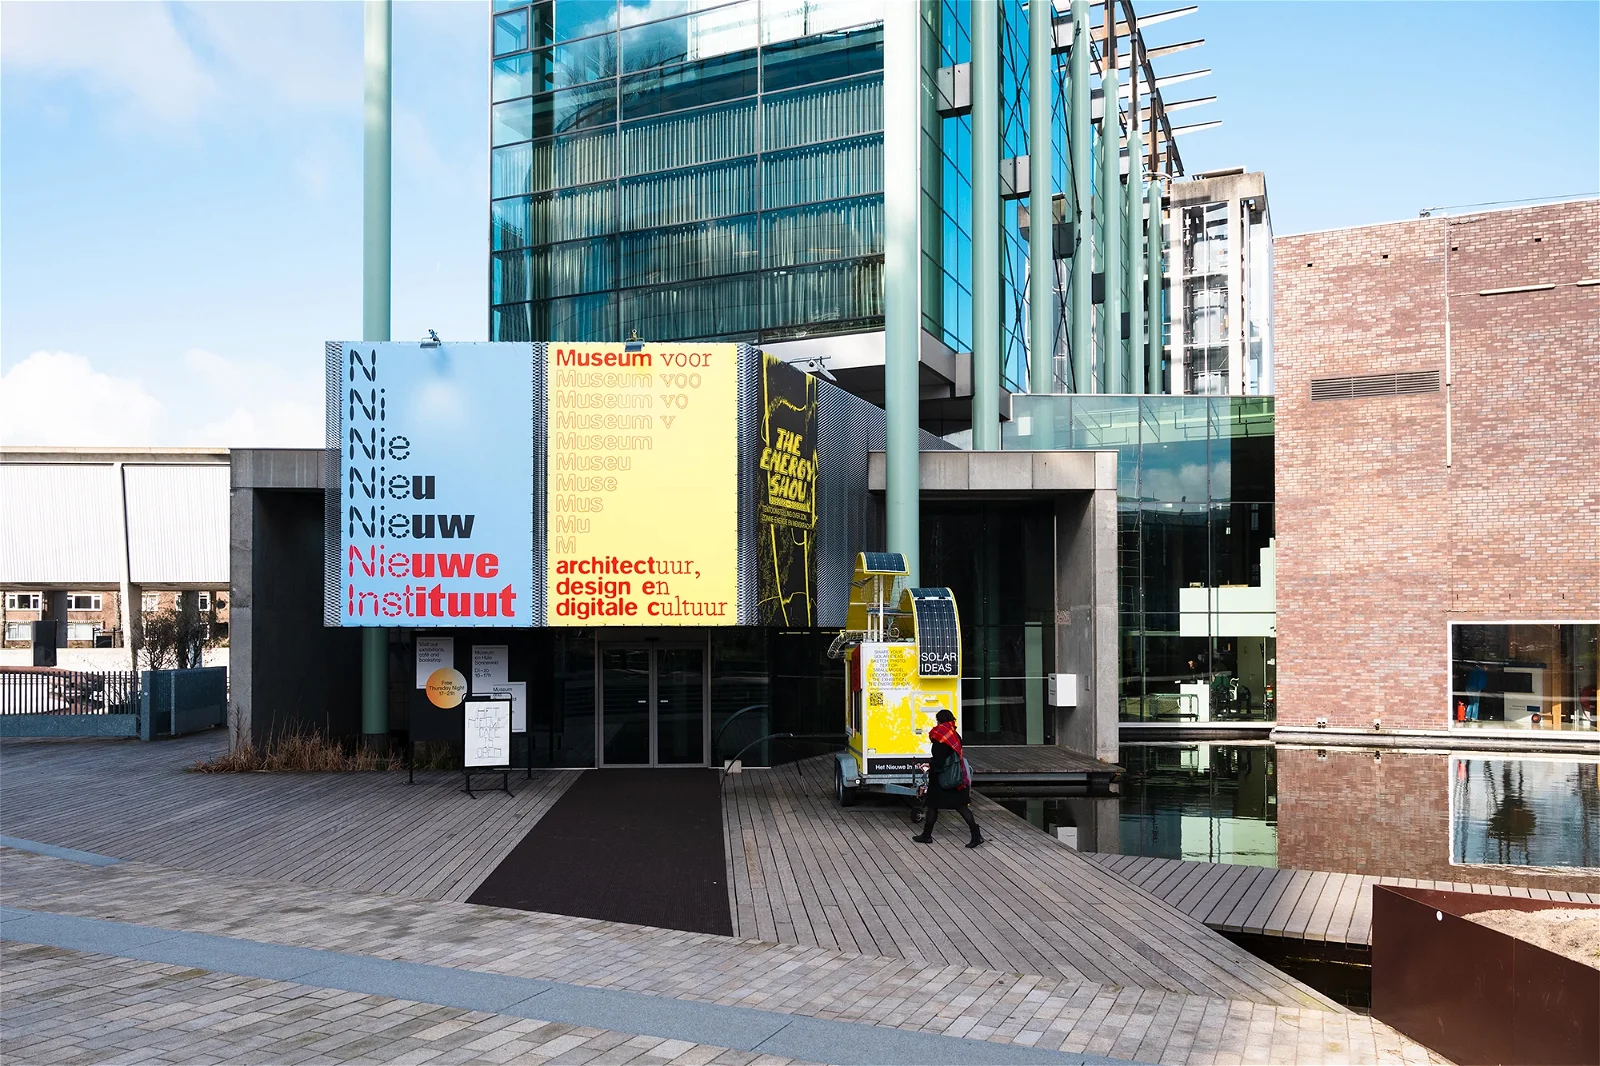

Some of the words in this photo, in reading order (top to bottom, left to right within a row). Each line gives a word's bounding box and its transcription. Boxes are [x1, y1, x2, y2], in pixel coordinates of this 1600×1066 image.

[350, 350, 376, 382] N
[556, 349, 652, 366] Museum
[660, 352, 712, 367] voor
[556, 370, 652, 388] Museum
[660, 373, 702, 388] voo
[350, 388, 385, 420] Ni
[556, 390, 652, 408] Museum
[660, 394, 688, 409] vo
[556, 411, 652, 430] Museum
[660, 414, 676, 430] v
[350, 428, 410, 460] Nie
[556, 432, 652, 450] Museum
[776, 428, 802, 456] THE
[556, 453, 631, 471] Museu
[760, 446, 814, 482] ENERGY
[350, 466, 435, 500] Nieu
[556, 474, 618, 492] Muse
[770, 474, 806, 502] SHOW
[556, 494, 603, 513] Mus
[350, 506, 474, 538] Nieuw
[556, 515, 590, 533] Mu
[556, 536, 576, 554] M
[348, 544, 498, 578] Nieuwe
[556, 556, 700, 579] architectuur,
[556, 577, 630, 598] design
[642, 580, 670, 595] en
[348, 584, 516, 618] Instituut
[556, 598, 638, 620] digitale
[648, 596, 728, 616] cultuur
[921, 653, 957, 661] SOLAR
[921, 664, 952, 672] IDEAS
